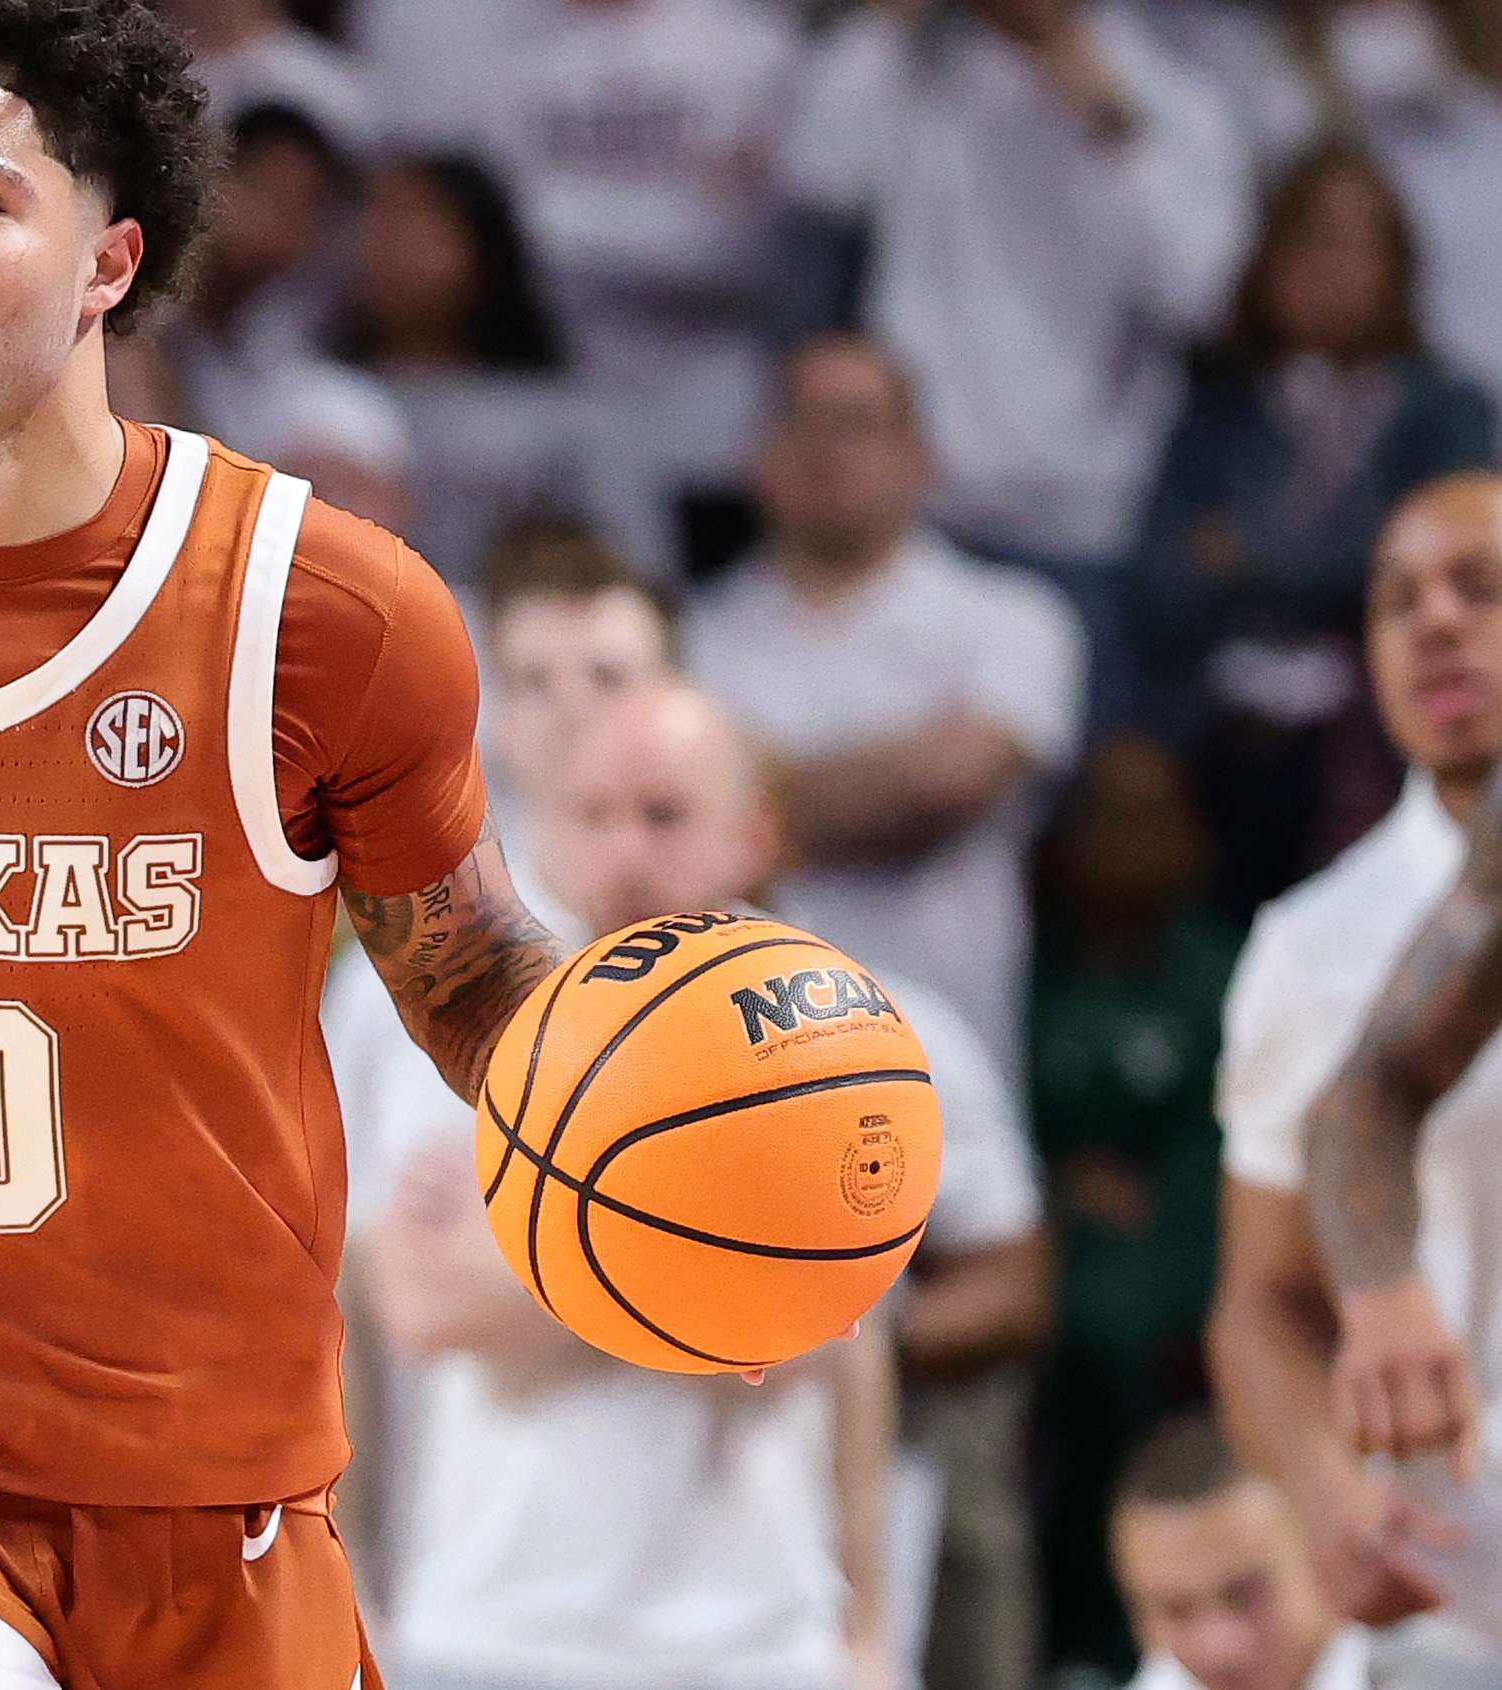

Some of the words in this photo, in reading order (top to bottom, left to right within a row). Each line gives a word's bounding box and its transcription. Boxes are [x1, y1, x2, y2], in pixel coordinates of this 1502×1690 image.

[96, 698, 177, 780] SEC
[731, 968, 902, 1046] NCAA
[754, 1030, 835, 1062] OFFICIAL
